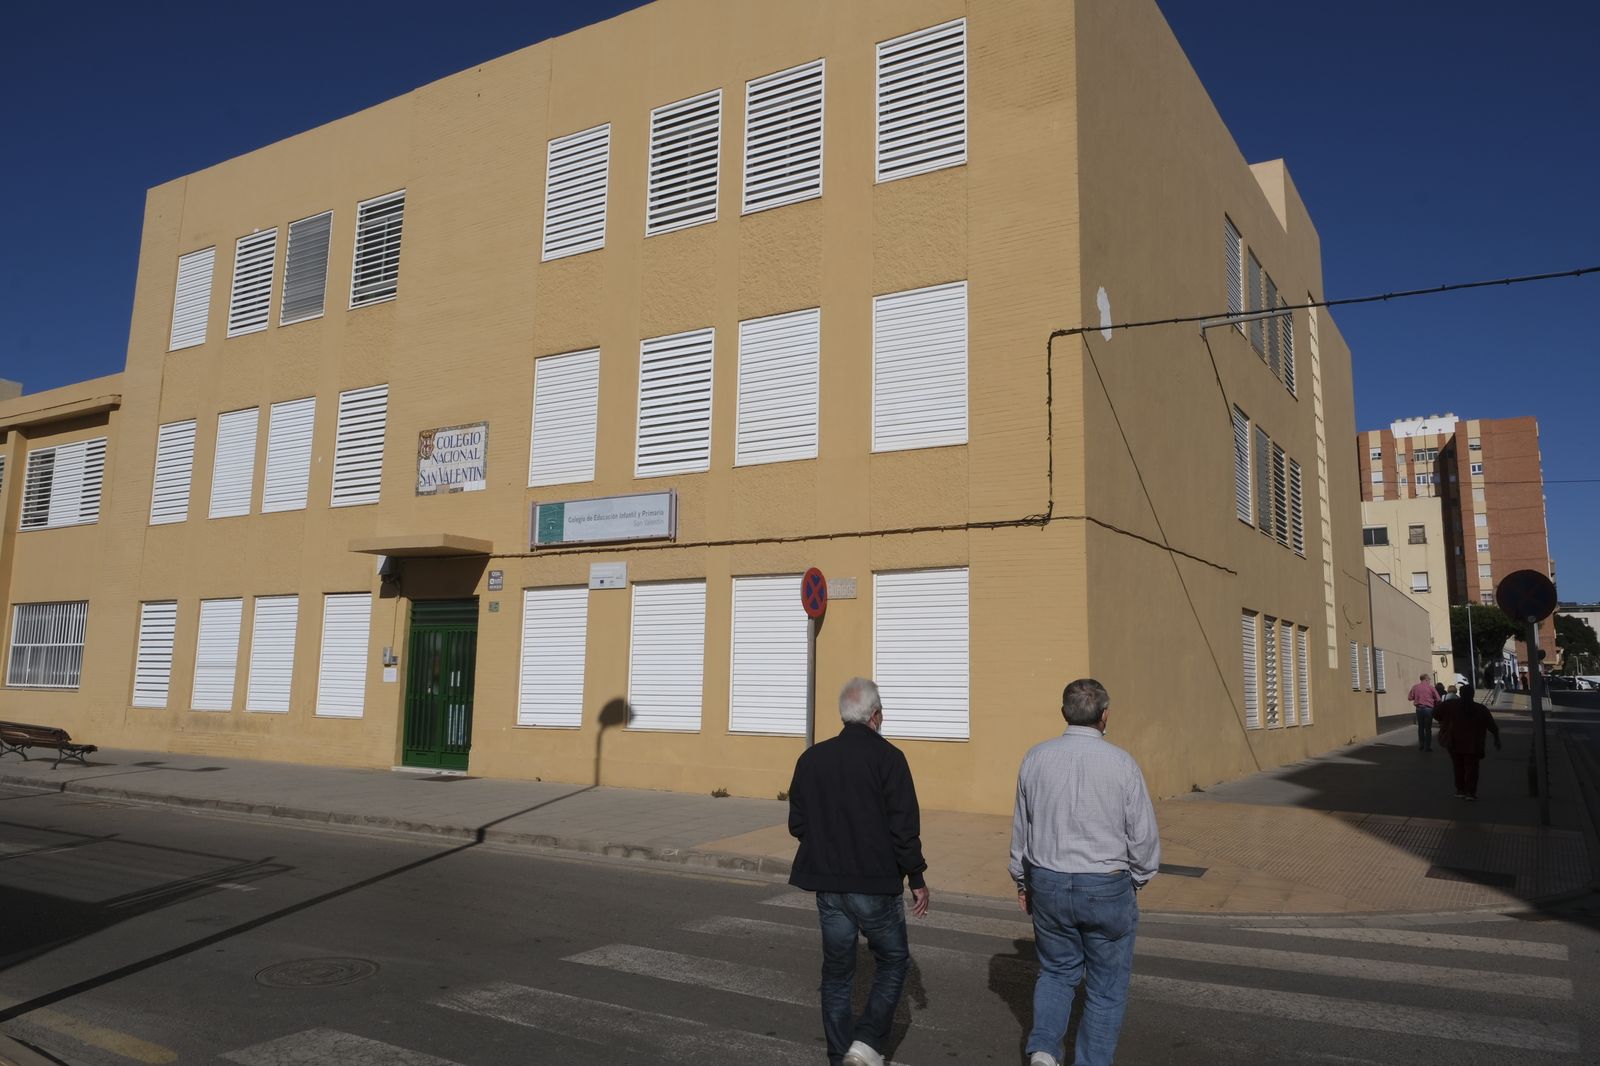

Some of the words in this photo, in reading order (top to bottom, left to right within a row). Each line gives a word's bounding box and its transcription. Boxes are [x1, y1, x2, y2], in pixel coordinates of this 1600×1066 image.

[436, 431, 481, 450] COLEGIO
[431, 447, 481, 465] NACIONAL
[419, 469, 437, 488] SAN
[567, 516, 585, 524] Colegio
[587, 514, 593, 522] de
[593, 512, 618, 521] Educación
[619, 510, 637, 519] Infantil
[642, 509, 664, 517] Primaria
